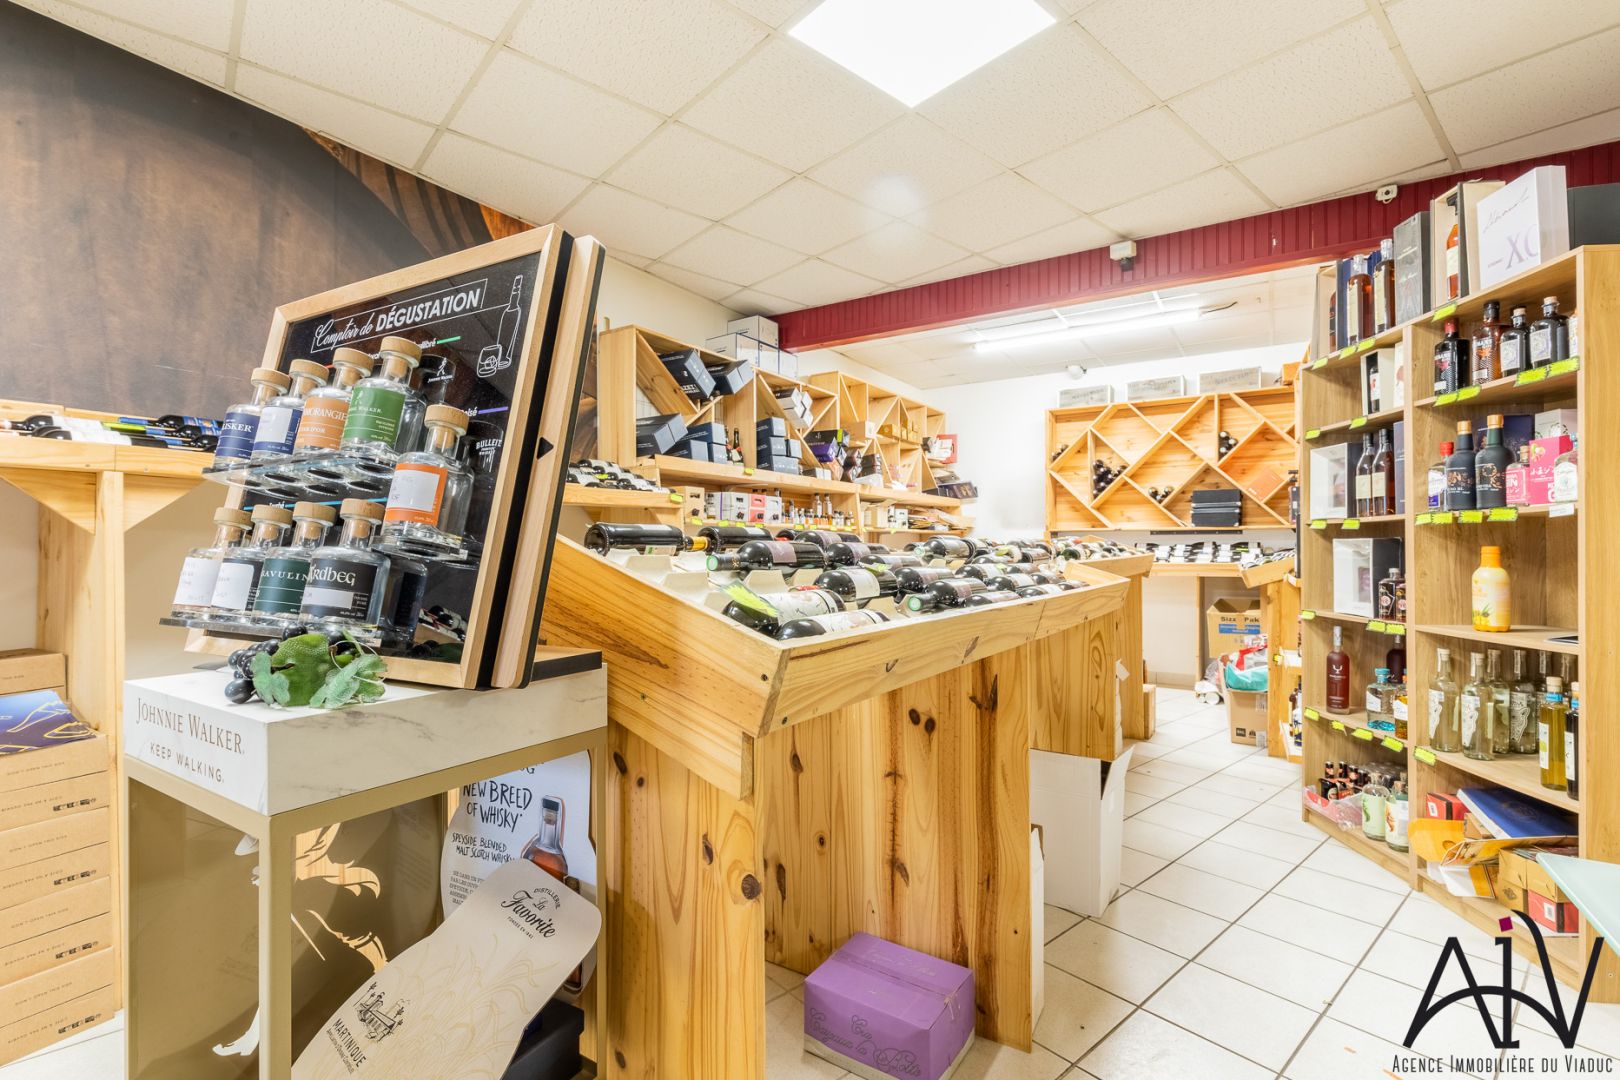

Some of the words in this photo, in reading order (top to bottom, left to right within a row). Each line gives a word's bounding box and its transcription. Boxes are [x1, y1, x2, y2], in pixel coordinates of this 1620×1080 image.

[315, 318, 359, 350] Comptoir
[359, 313, 374, 336] de
[375, 288, 481, 332] DÉGUSTATION
[262, 570, 307, 581] AVULIN
[136, 697, 183, 733] JOHNNIE
[150, 742, 171, 760] KEEP
[463, 781, 487, 798] NEW
[489, 780, 532, 810] BREED
[467, 802, 478, 817] OF
[452, 832, 477, 847] SPEYSIDE
[480, 837, 507, 852] BLENDED
[456, 845, 469, 857] MALT
[470, 847, 490, 861] SCOTCH
[534, 887, 560, 910] DISTILLERIE
[501, 890, 555, 938] Favorite
[333, 1018, 366, 1067] MARTINIQUE
